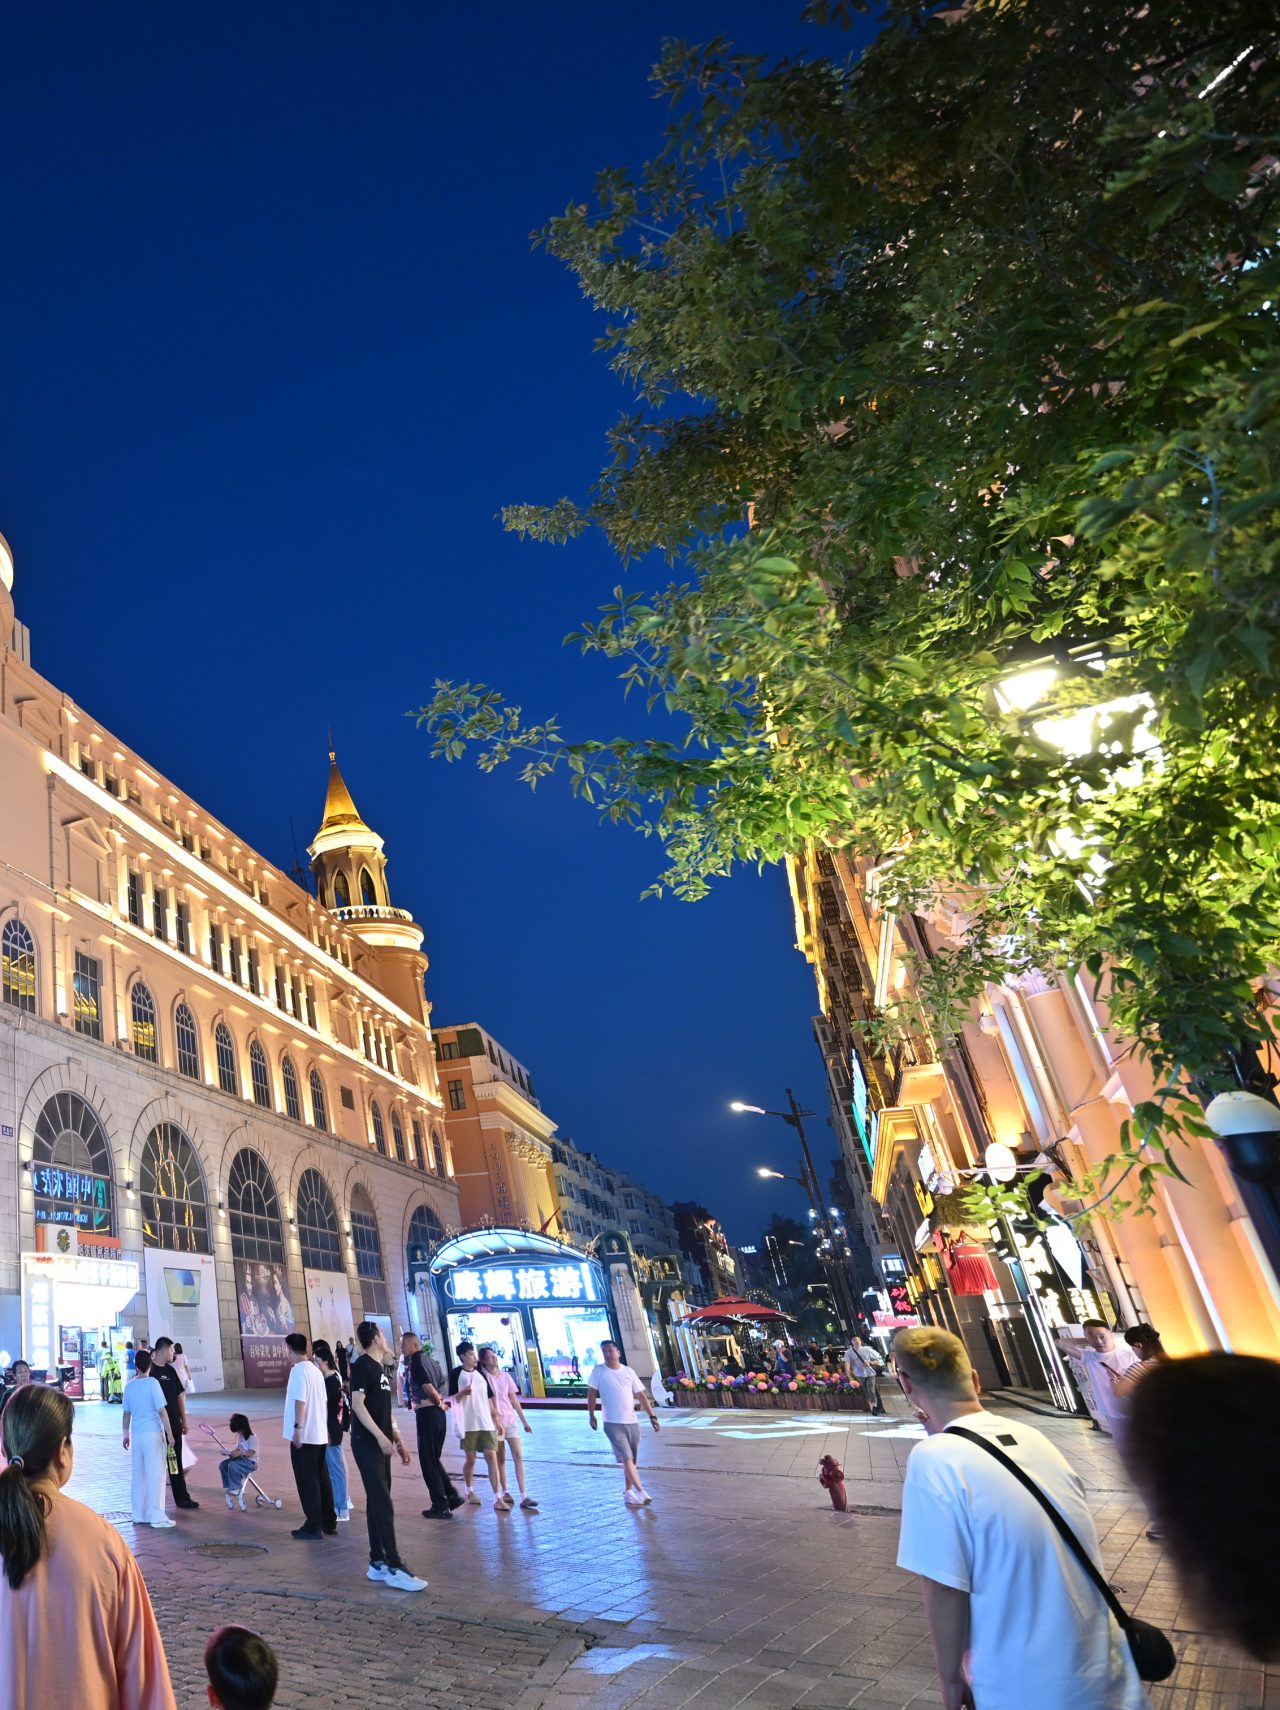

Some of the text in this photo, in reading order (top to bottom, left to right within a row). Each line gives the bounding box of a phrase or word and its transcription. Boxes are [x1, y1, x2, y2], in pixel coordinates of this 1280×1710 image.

[453, 1267, 583, 1301] 康辉旅游
[890, 1286, 913, 1313] 砂锅
